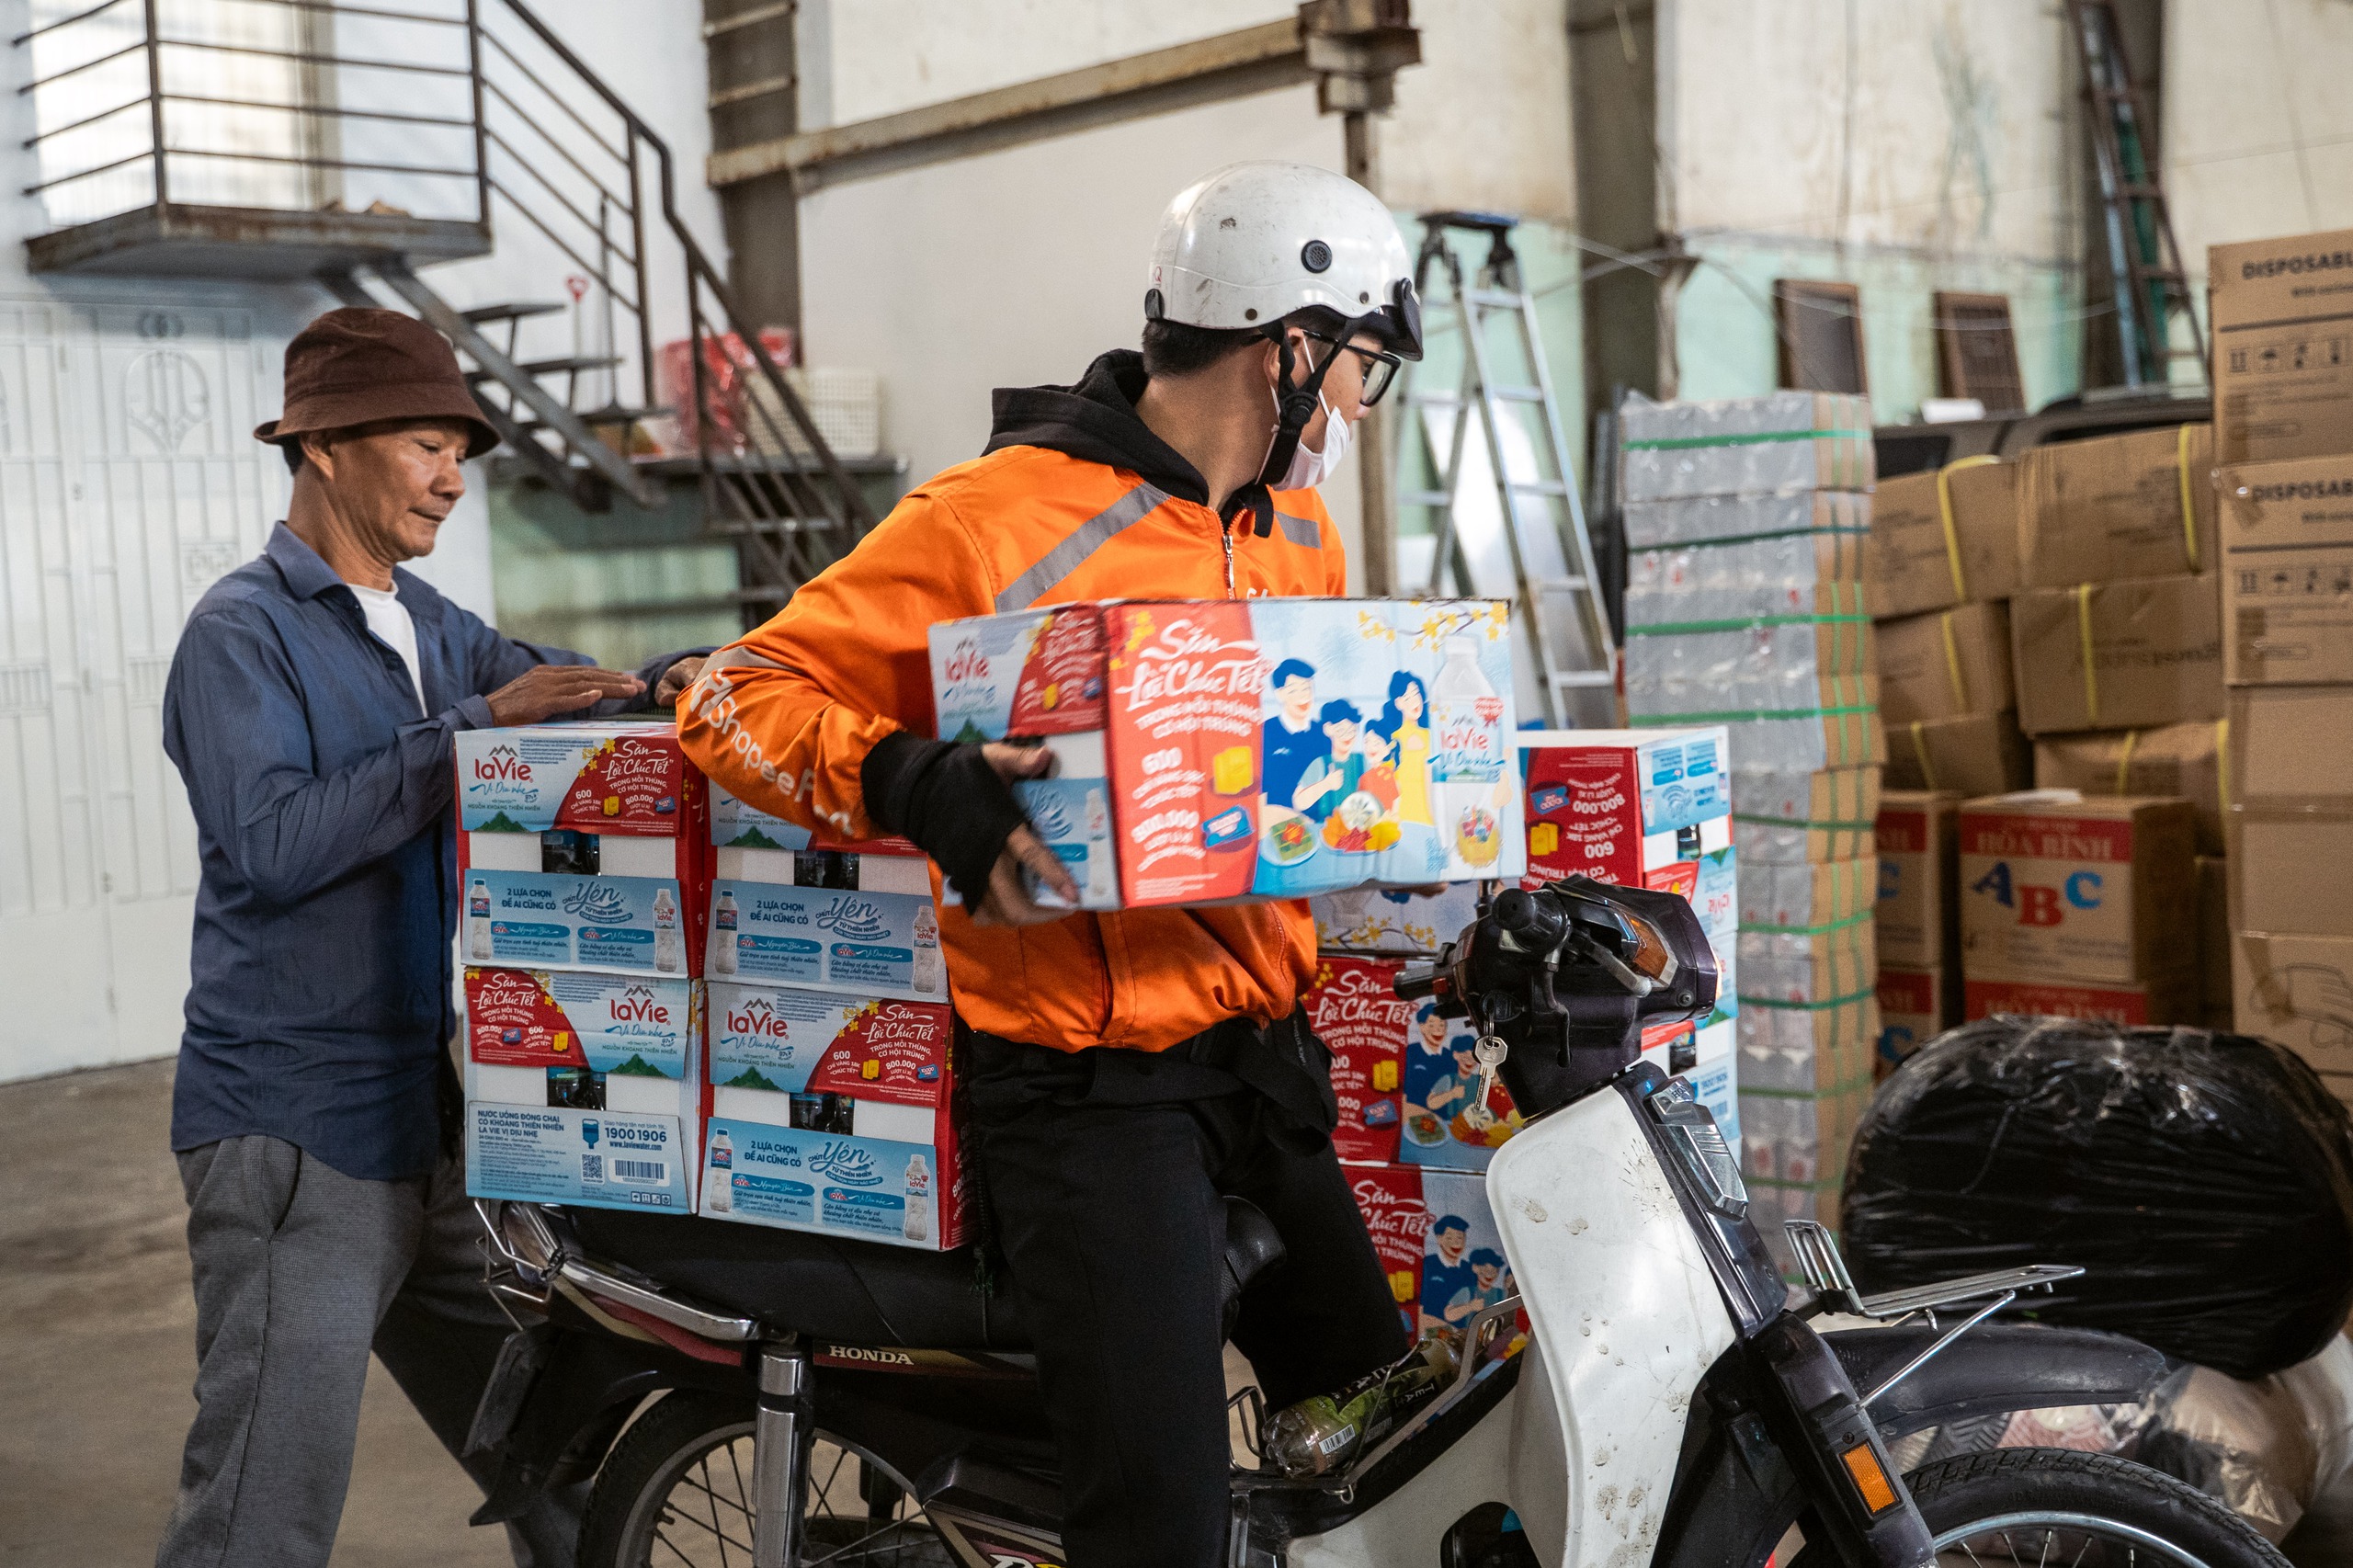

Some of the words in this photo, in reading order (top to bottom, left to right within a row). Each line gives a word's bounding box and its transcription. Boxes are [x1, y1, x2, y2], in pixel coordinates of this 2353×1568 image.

[612, 740, 667, 758] Săn
[475, 756, 531, 781] laVie
[601, 760, 622, 781] Lời
[609, 778, 631, 790] TRONG
[575, 790, 592, 800] 600
[625, 794, 654, 804] 800.000
[1573, 793, 1625, 814] 800.000
[1585, 841, 1615, 858] 600
[507, 889, 512, 897] 2
[529, 889, 551, 900] CHỌN
[569, 881, 620, 910] Yên
[1971, 861, 2103, 926] ABC
[764, 901, 779, 911] LỰA
[781, 903, 804, 914] CHỌN
[822, 896, 878, 926] Yên
[773, 913, 795, 924] CŨNG
[483, 973, 534, 989] Săn
[1324, 969, 1395, 996] Săn
[472, 990, 493, 1010] Lời
[481, 1007, 500, 1018] TRONG
[611, 997, 668, 1023] laVie
[875, 1004, 934, 1021] Săn
[529, 1026, 543, 1035] 600
[728, 1010, 788, 1037] laVie
[861, 1022, 884, 1043] Lời
[870, 1042, 892, 1052] TRONG
[834, 1051, 850, 1060] 600
[1332, 1055, 1350, 1069] 00
[885, 1060, 915, 1070] 800.000
[605, 1128, 635, 1140] 1900
[637, 1130, 666, 1142] 1906
[609, 1141, 662, 1151] www.laviewater.com
[757, 1142, 773, 1152] LỰA
[775, 1144, 797, 1155] CHỌN
[767, 1154, 789, 1165] CŨNG
[814, 1141, 870, 1168] Yên
[829, 1346, 914, 1366] HONDA
